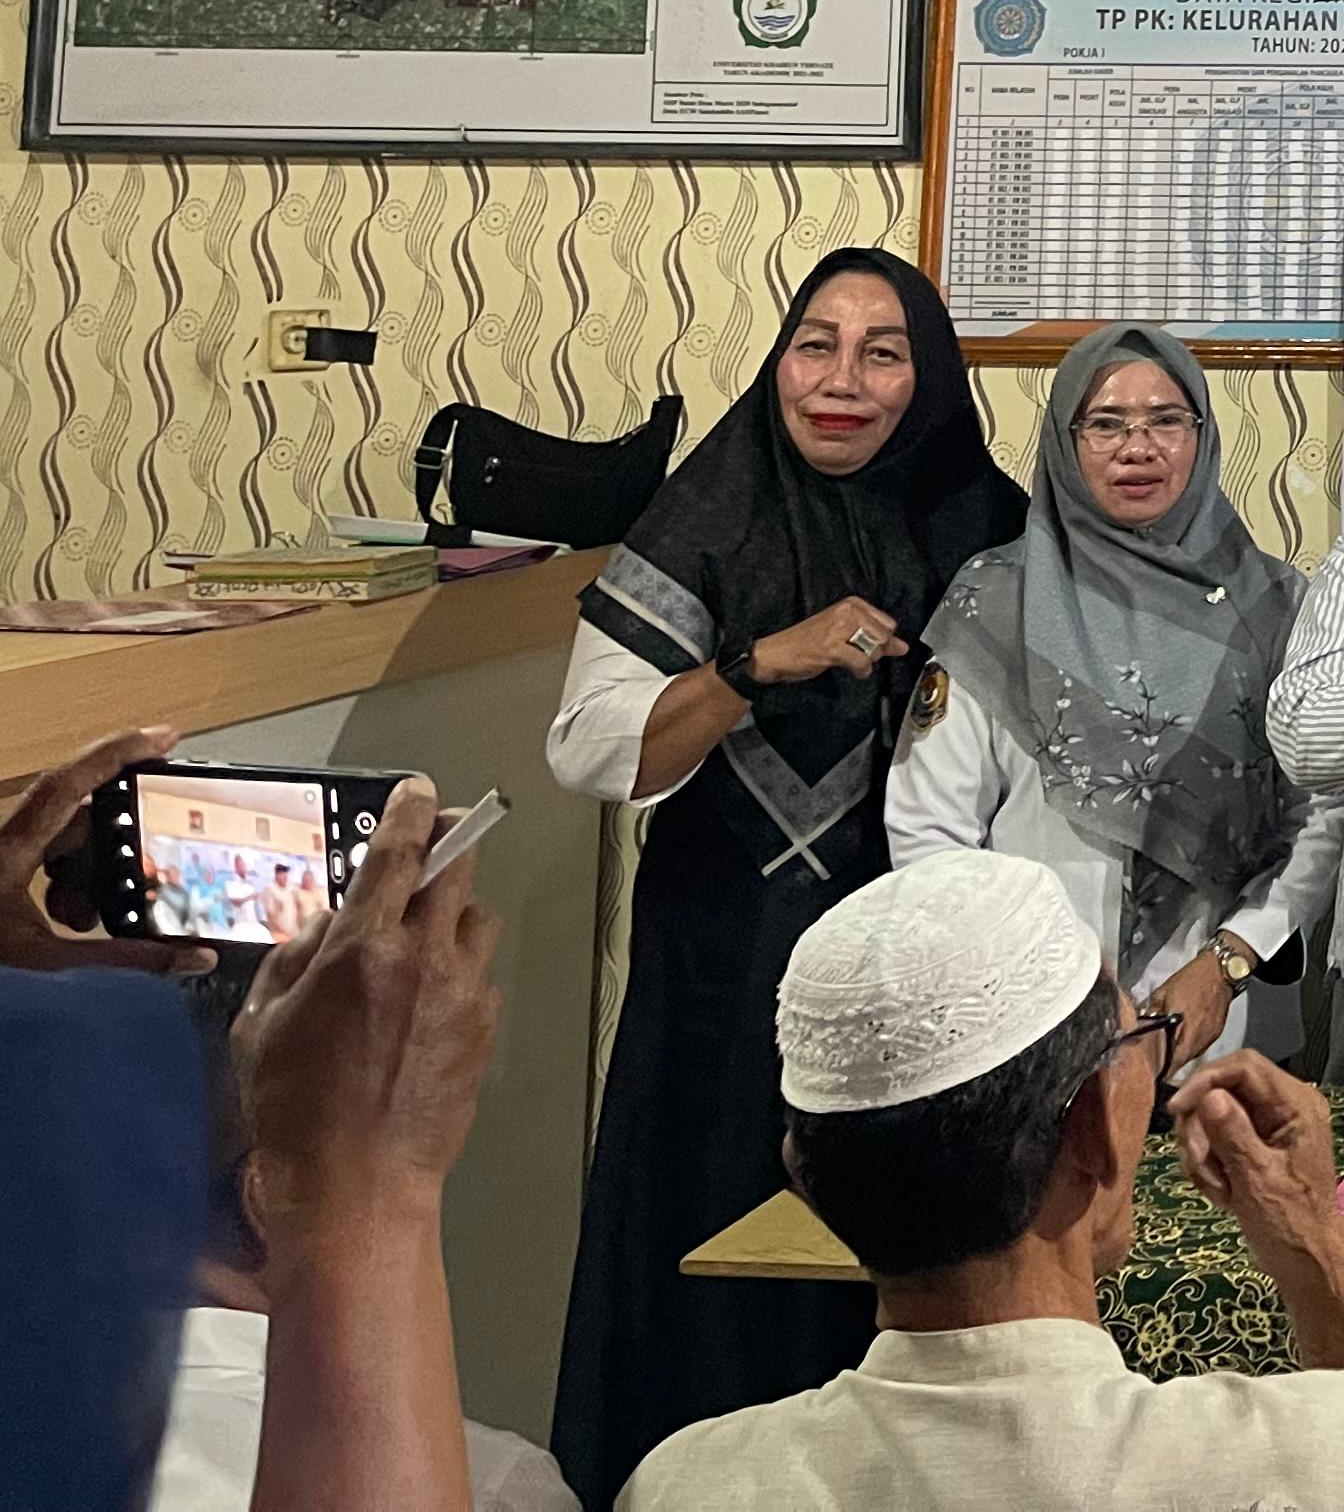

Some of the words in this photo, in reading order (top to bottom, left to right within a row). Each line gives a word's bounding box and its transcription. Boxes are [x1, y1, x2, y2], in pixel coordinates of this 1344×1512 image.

[1096, 9, 1126, 30] TP
[1135, 9, 1174, 30] PK:
[1183, 9, 1338, 31] KELURAHAN
[1063, 47, 1098, 58] POKJA
[1251, 37, 1316, 54] TAHUN:
